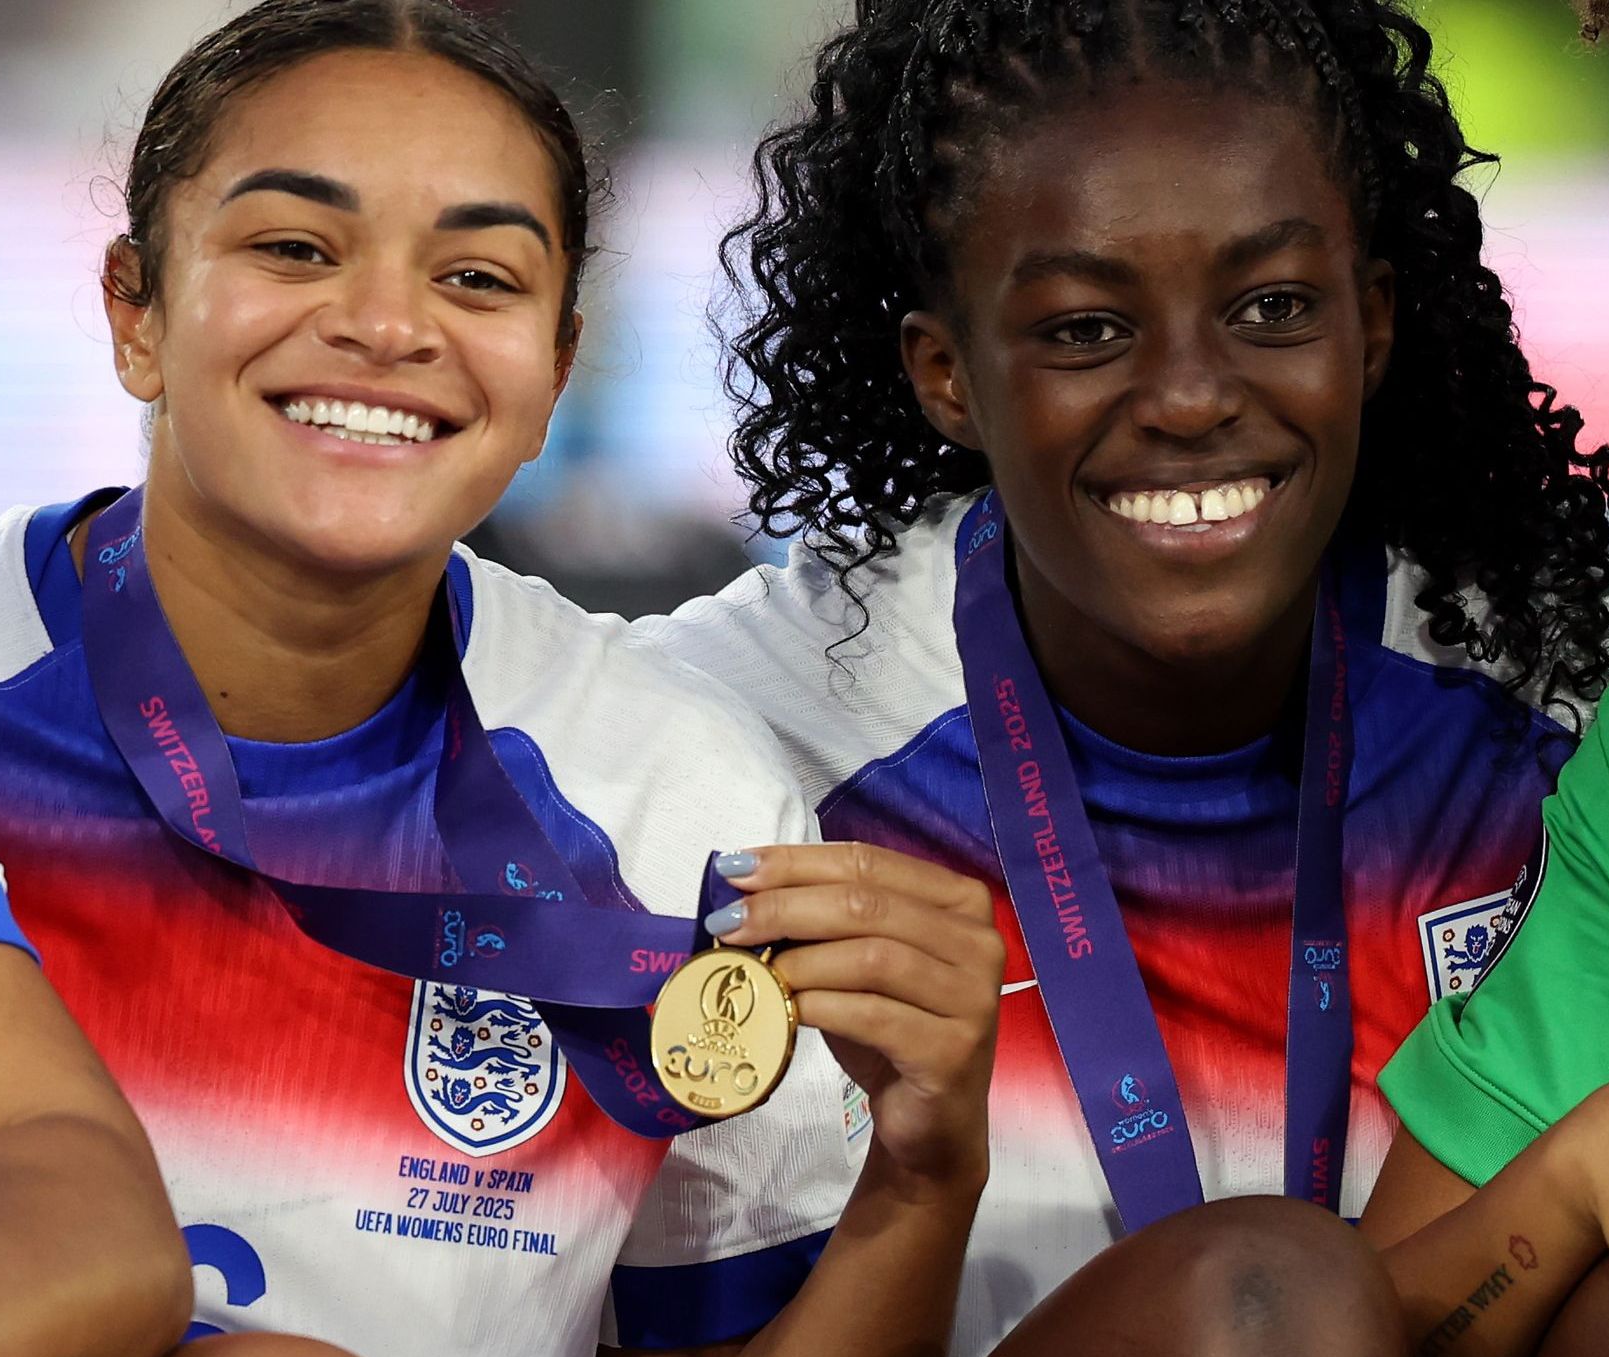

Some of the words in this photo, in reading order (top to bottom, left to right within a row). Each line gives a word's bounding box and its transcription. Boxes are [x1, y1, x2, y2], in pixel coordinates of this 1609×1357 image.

[996, 678, 1033, 752] 2025
[1017, 760, 1092, 959] SWITZERLAND
[398, 1156, 470, 1185] ENGLAND
[474, 1170, 485, 1188] v
[487, 1169, 534, 1193] SPAIN
[407, 1187, 430, 1209] 27
[432, 1191, 471, 1215] JULY
[472, 1196, 515, 1220] 2025
[355, 1209, 393, 1234] UEFA
[396, 1215, 464, 1243] WOMENS
[466, 1224, 509, 1250] EURO
[512, 1229, 558, 1256] FINAL
[1467, 1263, 1514, 1311] WHY
